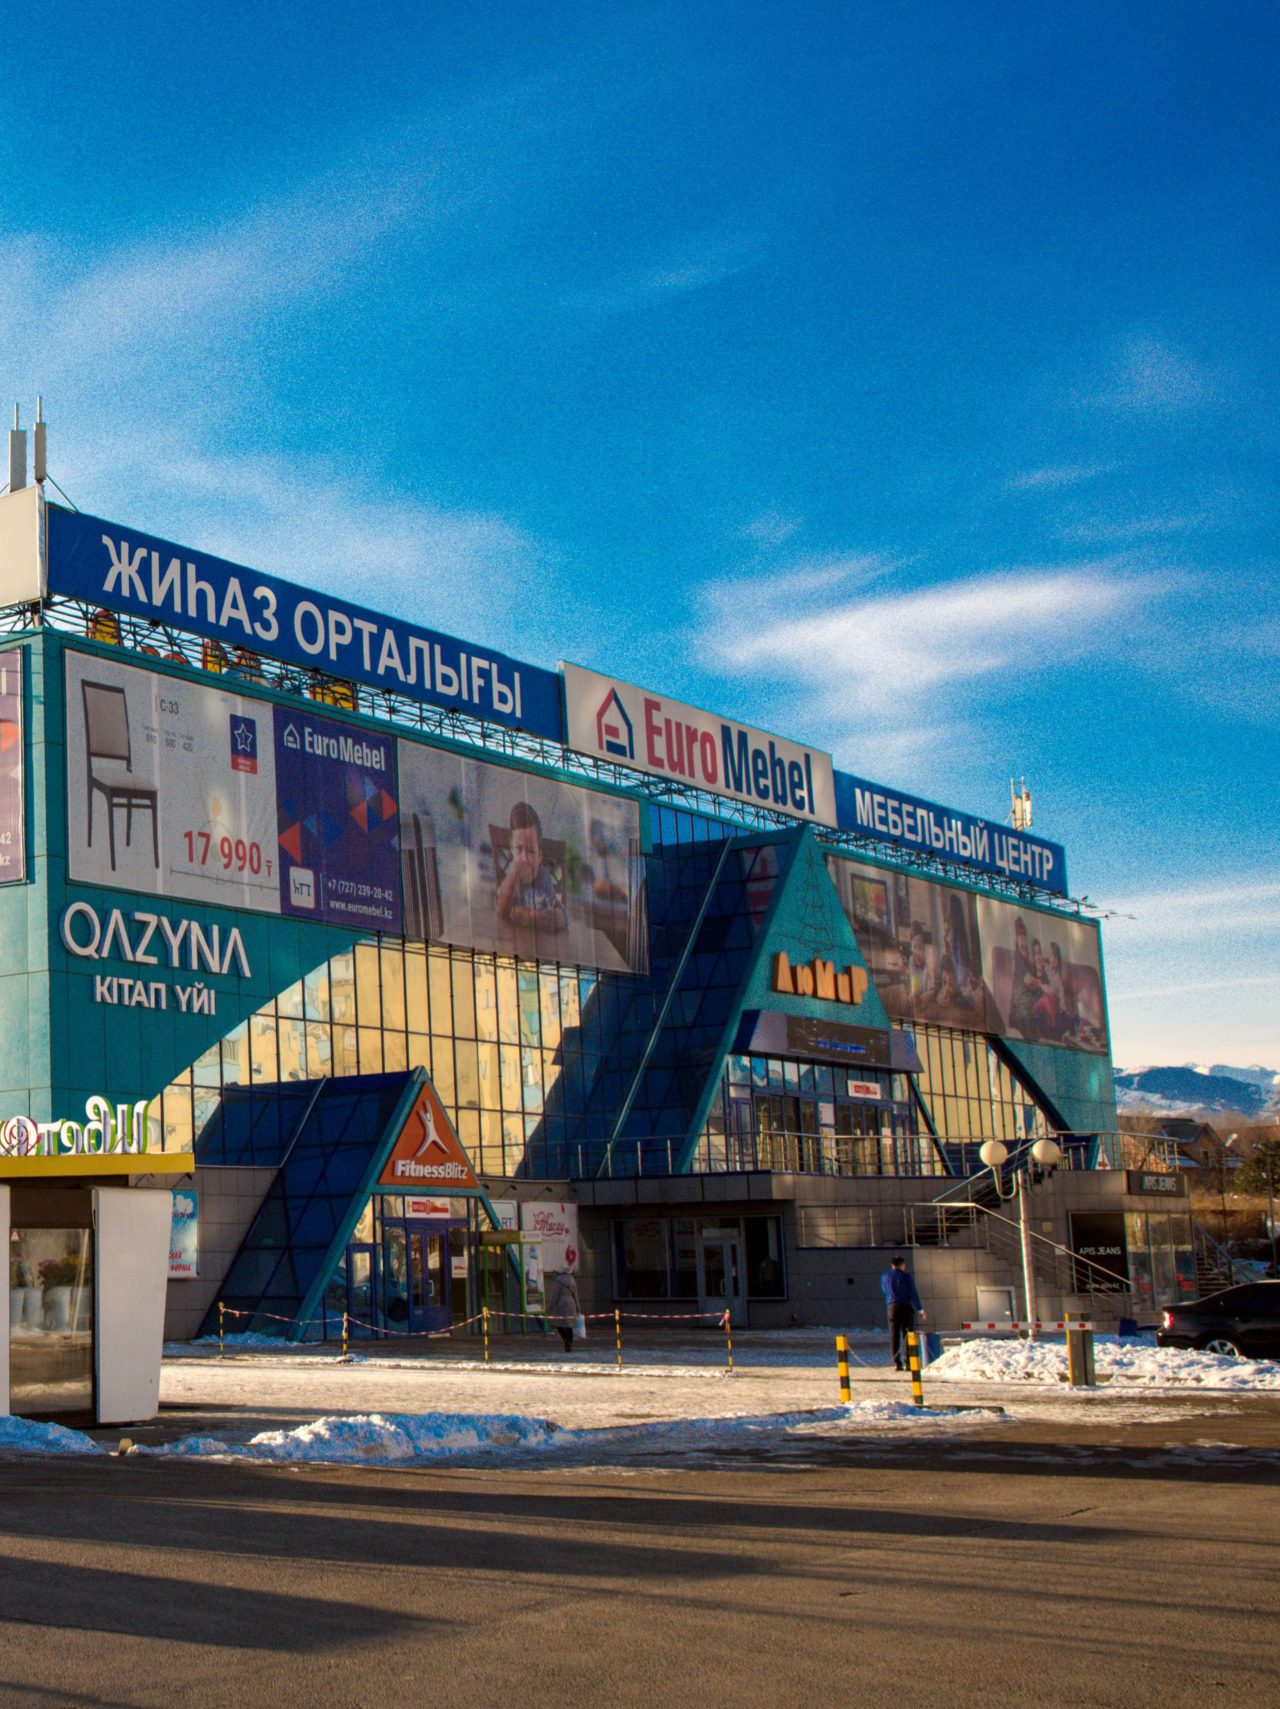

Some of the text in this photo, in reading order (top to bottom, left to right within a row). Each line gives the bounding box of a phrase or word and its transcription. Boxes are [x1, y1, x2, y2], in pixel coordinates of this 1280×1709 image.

[102, 534, 522, 719] ЖИҺАЗ ОРТАЛЫҒЫ
[855, 787, 1053, 881] МЕБЕЛЬНЫЙ ЦЕНТР
[183, 830, 211, 865] 17
[220, 835, 262, 875] 990
[338, 880, 357, 897] (727)
[358, 884, 393, 902] 239-20-42
[329, 899, 393, 919] www.euromebel.kz
[94, 975, 167, 1010] КІТАП
[1080, 1247, 1121, 1255] APIS JEANS
